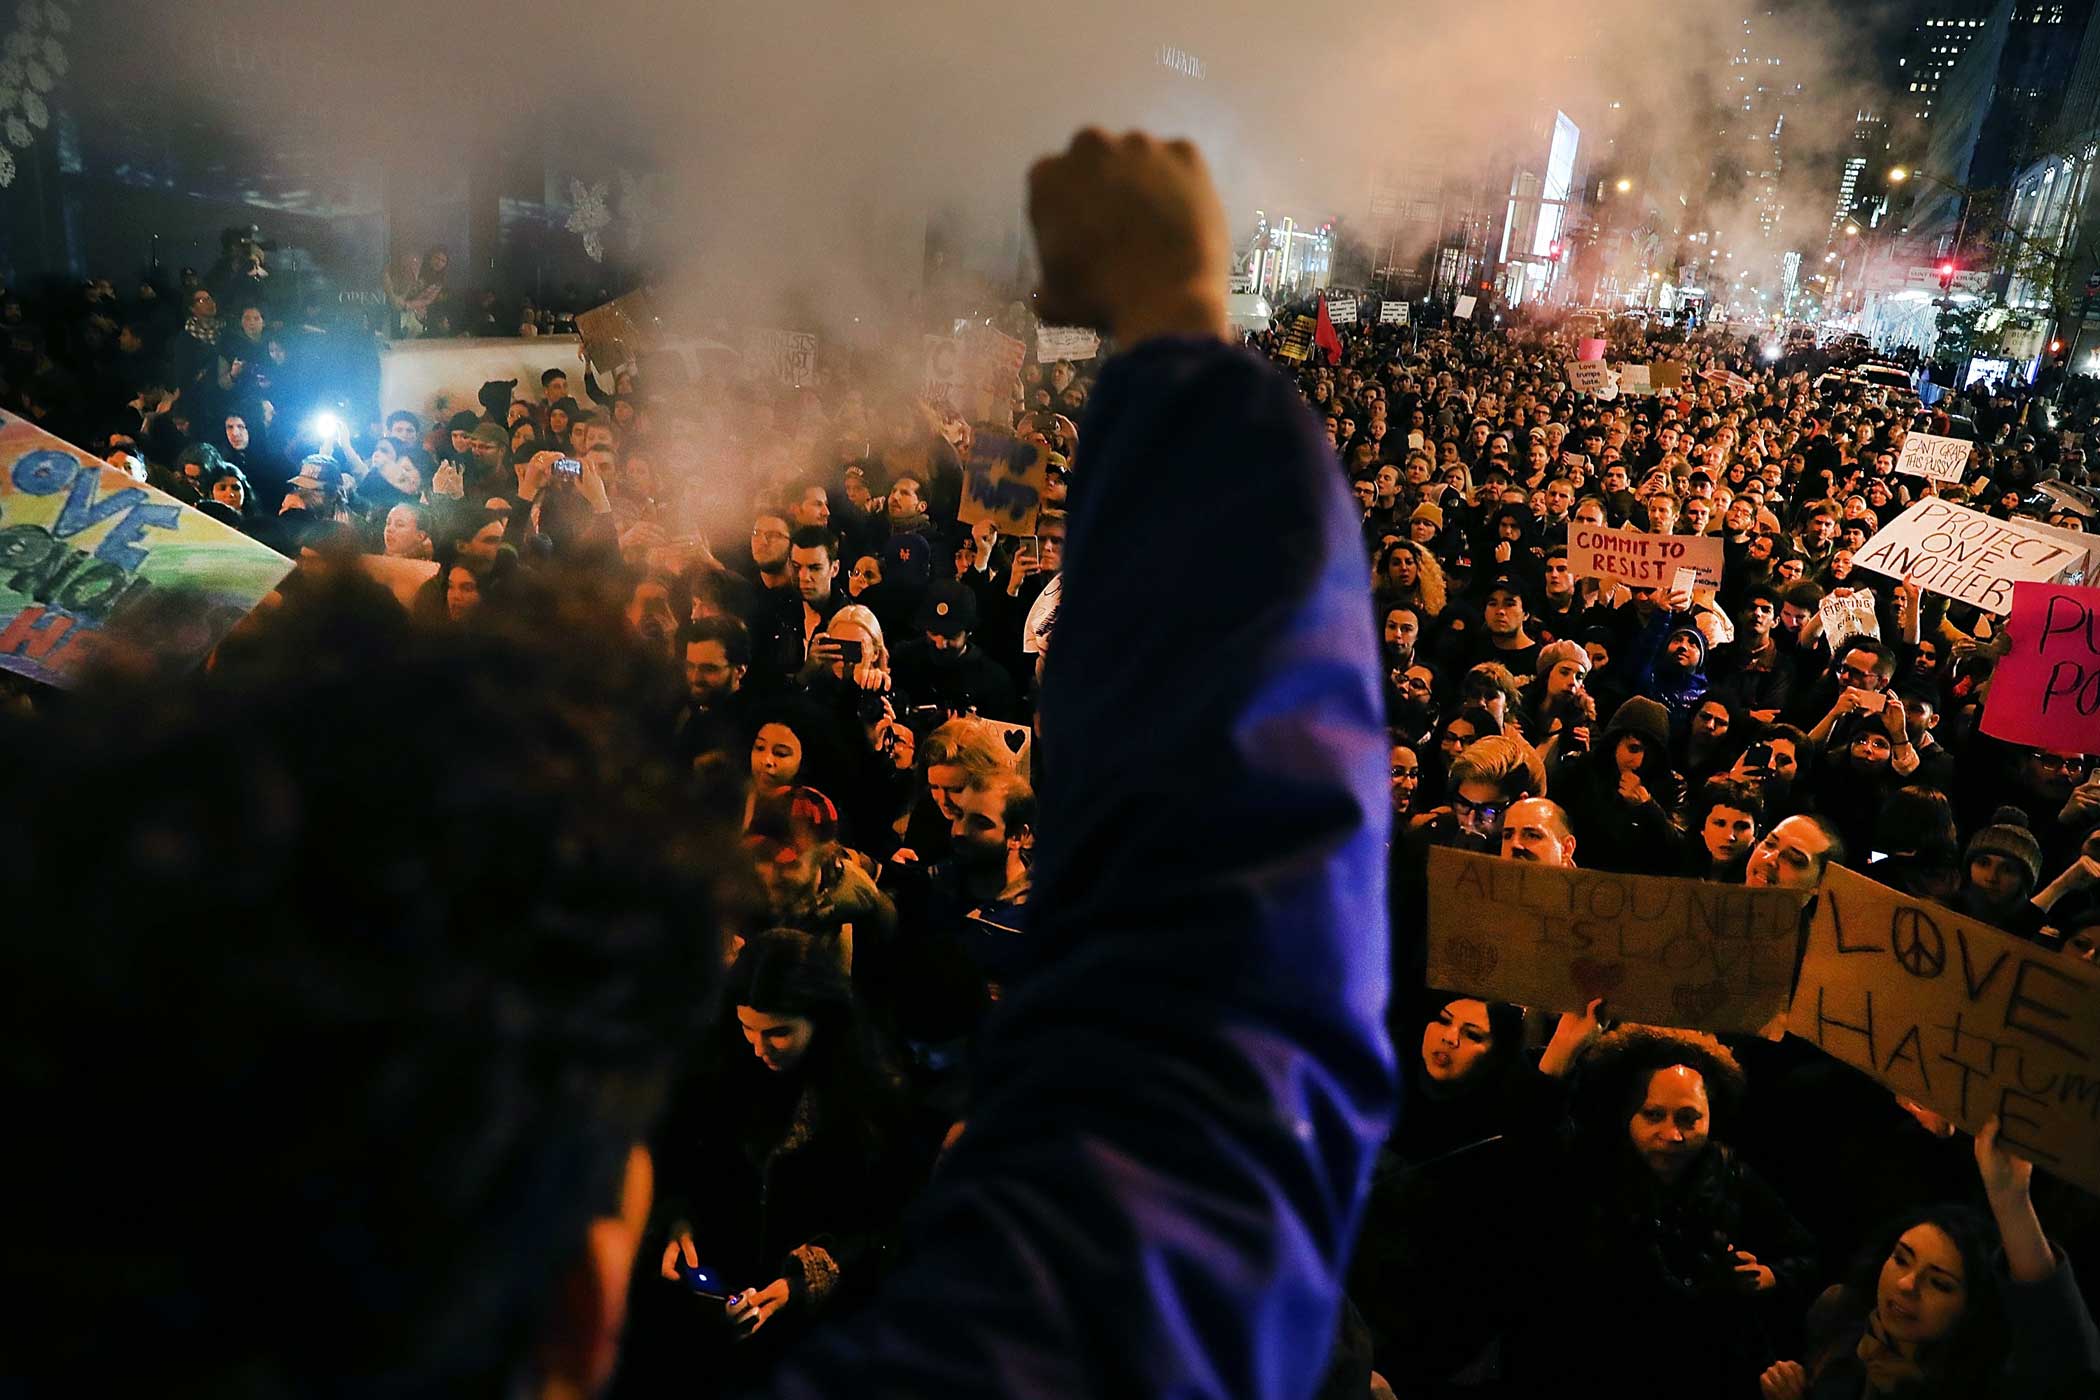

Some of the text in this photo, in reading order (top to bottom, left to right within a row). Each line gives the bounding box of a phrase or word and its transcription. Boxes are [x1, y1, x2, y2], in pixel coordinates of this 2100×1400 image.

[1905, 453, 1923, 468] THIS
[1940, 442, 1967, 461] GRAB
[0, 440, 181, 571] OVE
[1577, 532, 1686, 558] COMMIT TO
[1912, 503, 2073, 567] PROTECT
[1921, 532, 2005, 573] ONE
[1592, 553, 1667, 581] RESIST
[1864, 541, 2014, 608] ANOTHER
[1823, 599, 1870, 617] FIGHTING
[1455, 860, 1802, 941] ALL YOU NEED
[1535, 914, 1784, 986] IS LOVE
[1816, 986, 2062, 1164] HATE
